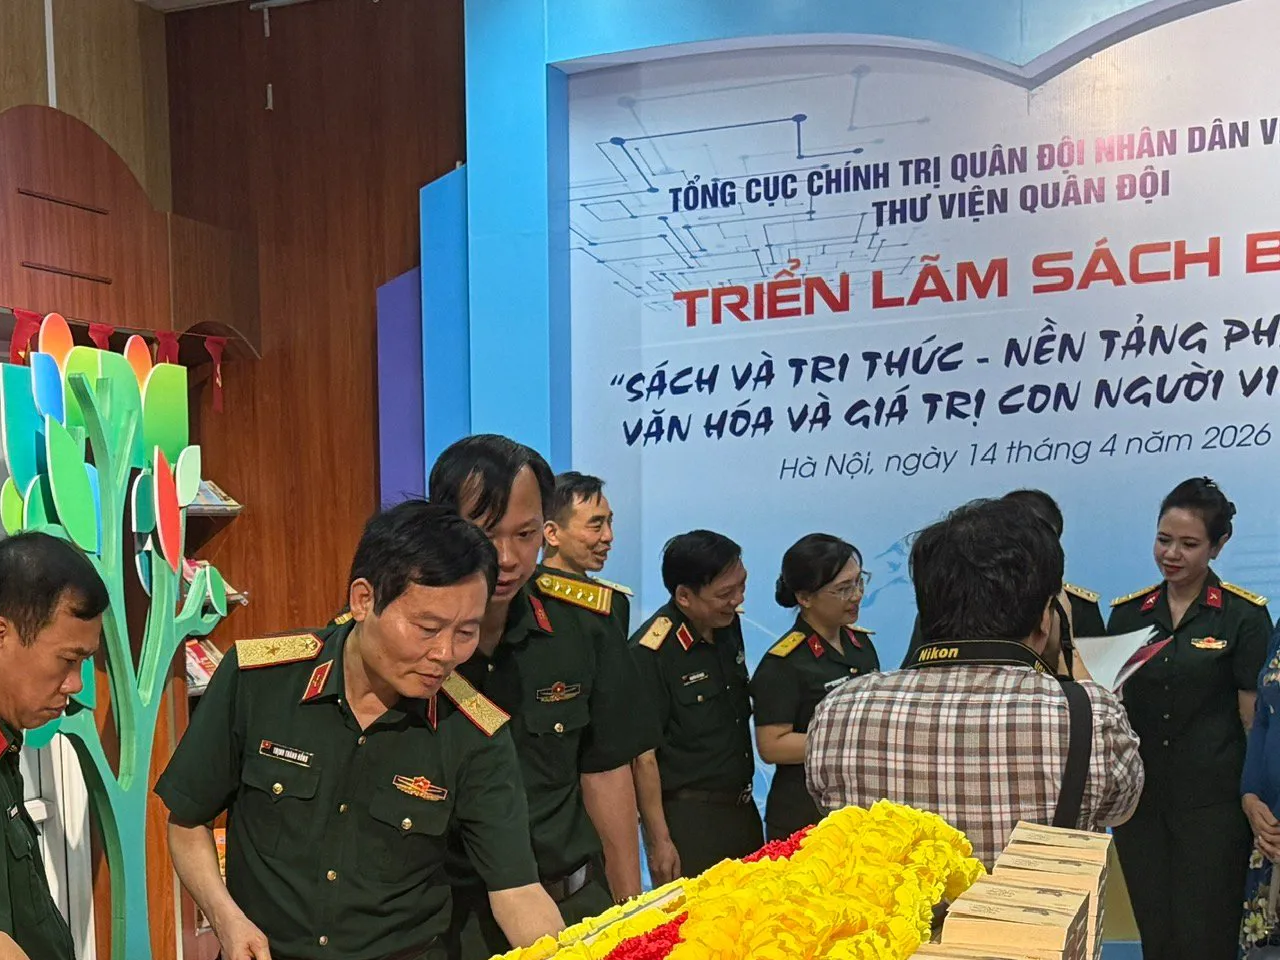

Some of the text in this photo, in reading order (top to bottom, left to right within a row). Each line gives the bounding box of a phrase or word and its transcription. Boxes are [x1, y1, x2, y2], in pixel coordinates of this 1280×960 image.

[669, 172, 735, 212] TỔNG
[745, 179, 797, 208] CỤC
[807, 164, 889, 197] CHÍNH
[899, 158, 940, 189] TRỊ
[950, 145, 1026, 184] QUÂN
[1036, 136, 1084, 173] ĐỘI
[1095, 129, 1177, 166] NHÂN
[1187, 119, 1248, 154] DÂN
[872, 169, 1170, 227] THƯ VIỆN QUÂN ĐỘI
[672, 257, 850, 328] TRIỂN
[872, 251, 1008, 308] LÃM
[1033, 235, 1221, 294] SÁCH
[730, 351, 775, 389] VÀ
[788, 353, 848, 384] TRI
[861, 335, 963, 376] THỨC
[1004, 317, 1086, 367] NỀN
[1099, 313, 1208, 359] TẢNG
[622, 362, 1280, 447] VĂN HÓA VÀ GIÁ TRỊ CON NGƯỜI VI
[779, 422, 1272, 480] Hà Nội, ngày 14 tháng 4 năm 2026
[918, 646, 960, 661] Nikon
